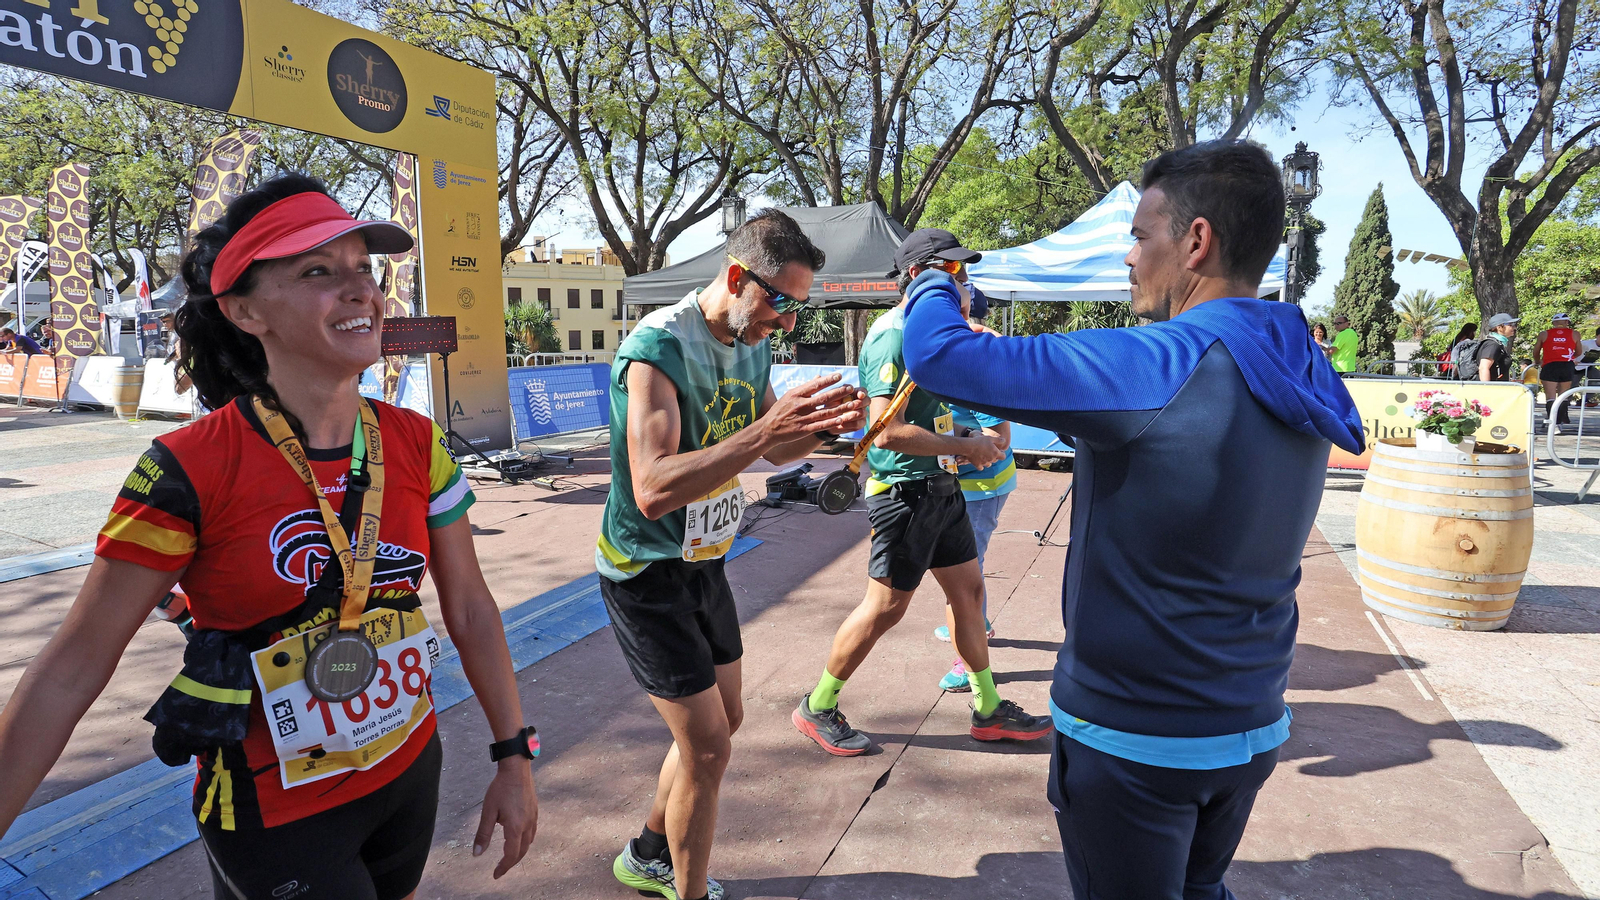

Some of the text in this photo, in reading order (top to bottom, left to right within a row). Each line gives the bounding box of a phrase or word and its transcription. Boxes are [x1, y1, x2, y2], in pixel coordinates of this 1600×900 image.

[263, 55, 306, 78] Sherry
[335, 73, 400, 111] Sherry
[357, 95, 391, 112] Promo
[453, 100, 490, 119] Diputación
[454, 115, 484, 130] de Cádiz
[450, 171, 487, 183] Ayuntamiento
[457, 179, 471, 187] Jerez
[451, 255, 477, 268] HSN
[63, 285, 88, 296] Sherry
[68, 339, 93, 348] Sherry
[553, 389, 604, 402] Ayuntamiento
[555, 400, 585, 411] de Jerez
[711, 413, 747, 440] Sherry
[371, 427, 379, 462] Sherry
[832, 488, 845, 500] 2023
[700, 493, 739, 534] 1226
[359, 518, 376, 557] Sherry
[330, 663, 357, 672] 2023
[352, 706, 402, 738] María Jesús
[353, 718, 405, 748] Torres Porras
